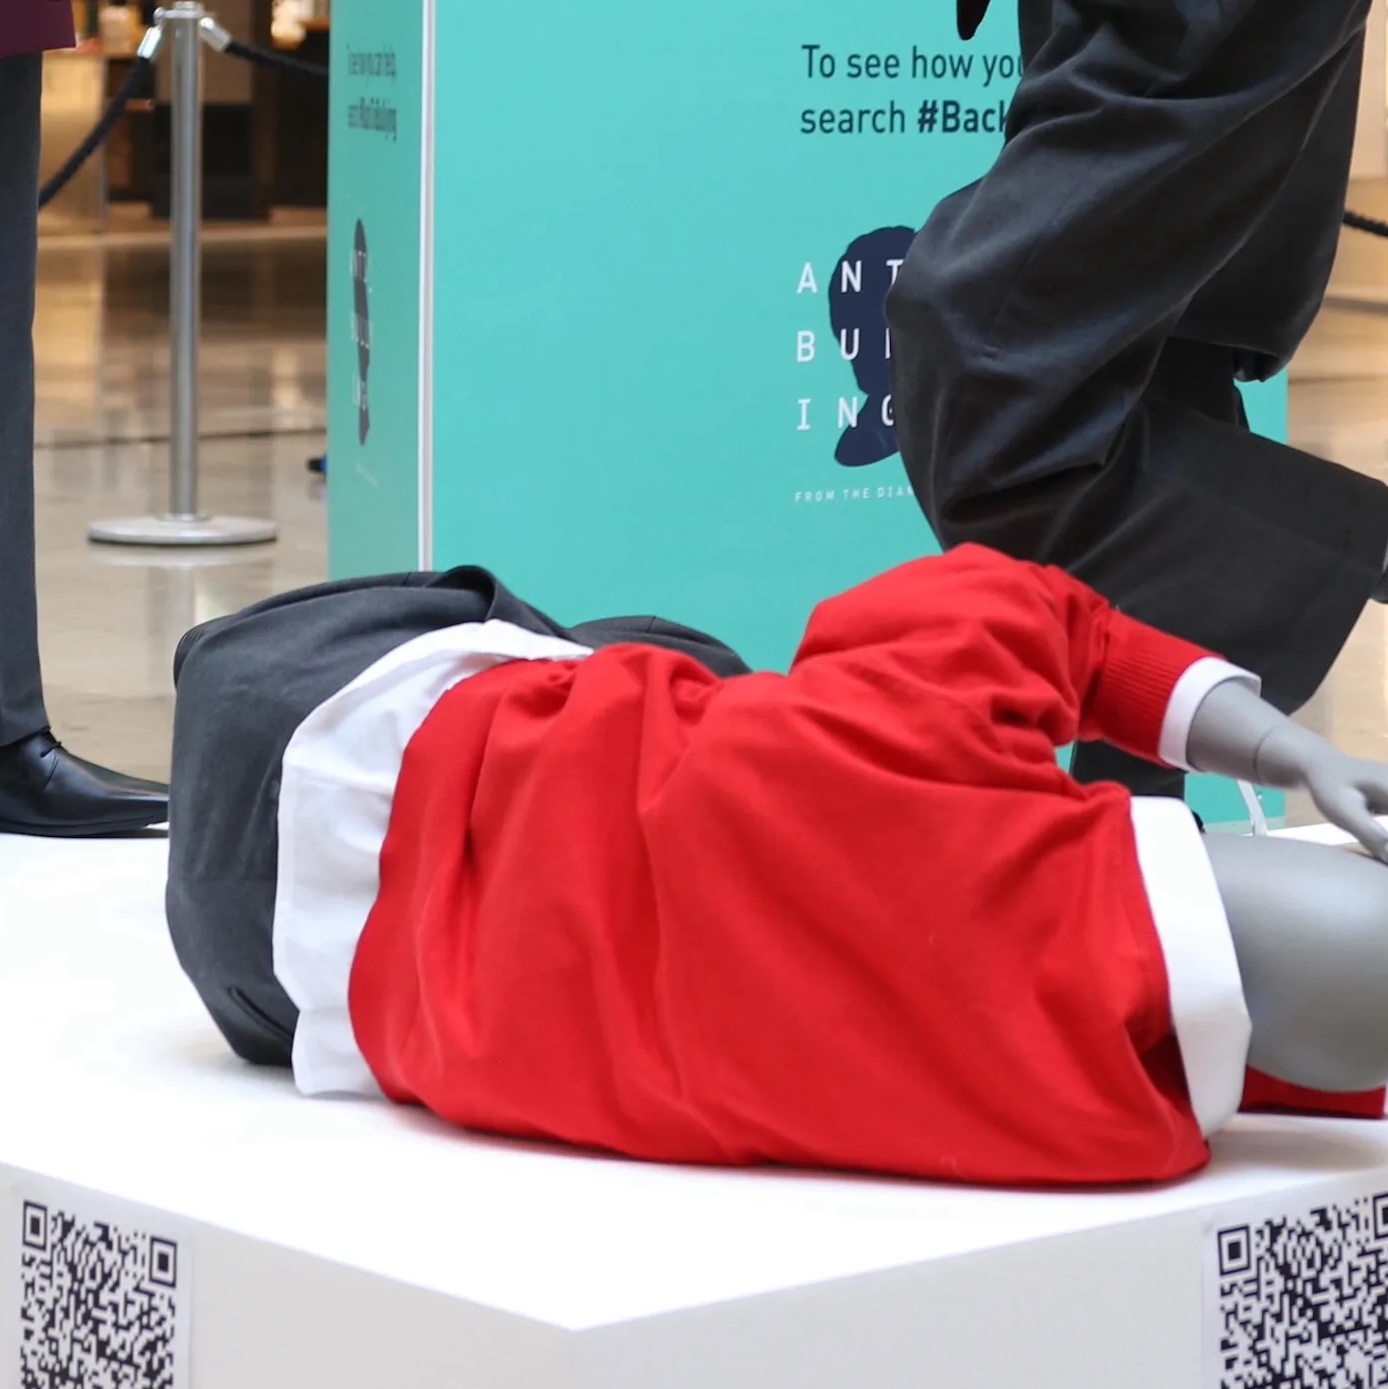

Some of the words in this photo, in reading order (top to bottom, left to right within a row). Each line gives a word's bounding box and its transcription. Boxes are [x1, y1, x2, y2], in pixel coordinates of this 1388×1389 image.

[801, 44, 835, 78] To
[847, 54, 900, 78] see
[912, 45, 973, 79] how
[801, 100, 905, 133] search
[795, 490, 835, 503] FROM
[843, 488, 870, 500] THE
